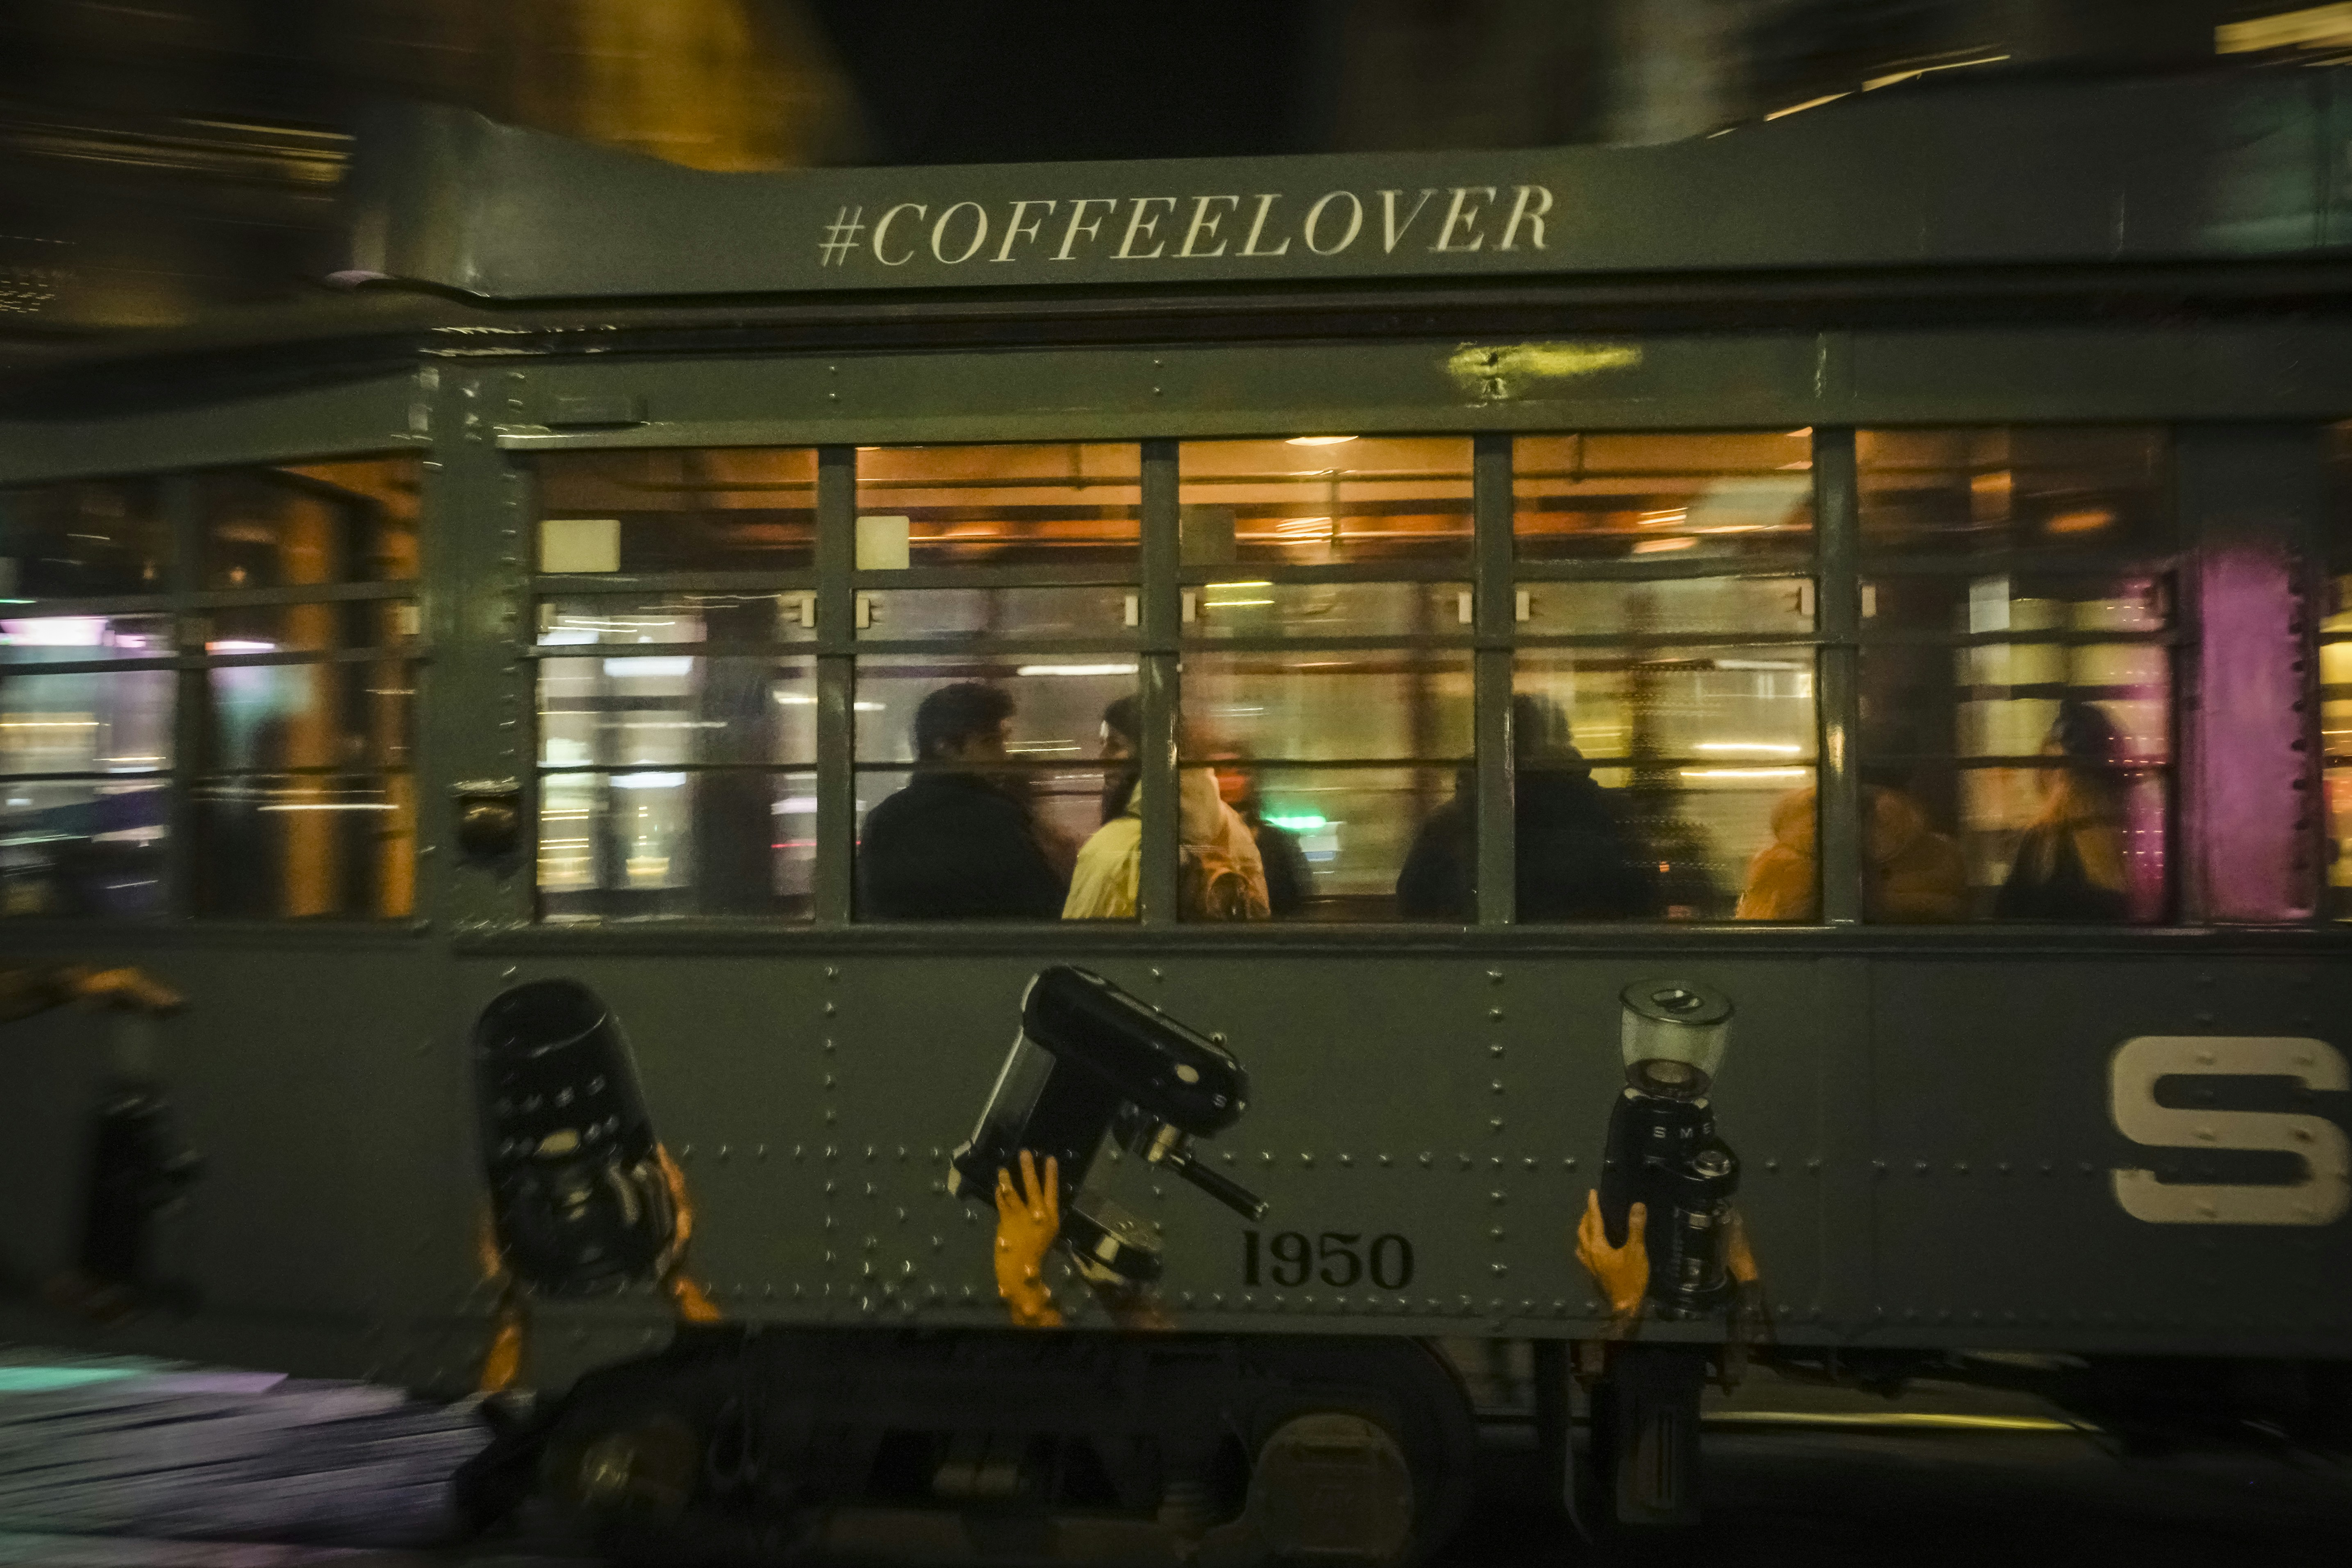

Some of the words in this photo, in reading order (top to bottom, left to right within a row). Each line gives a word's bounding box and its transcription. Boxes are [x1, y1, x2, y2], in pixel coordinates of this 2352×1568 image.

[818, 184, 1554, 267] #COFFEELOVER
[2109, 1035, 2352, 1226] S
[1244, 1231, 1415, 1290] 1950
